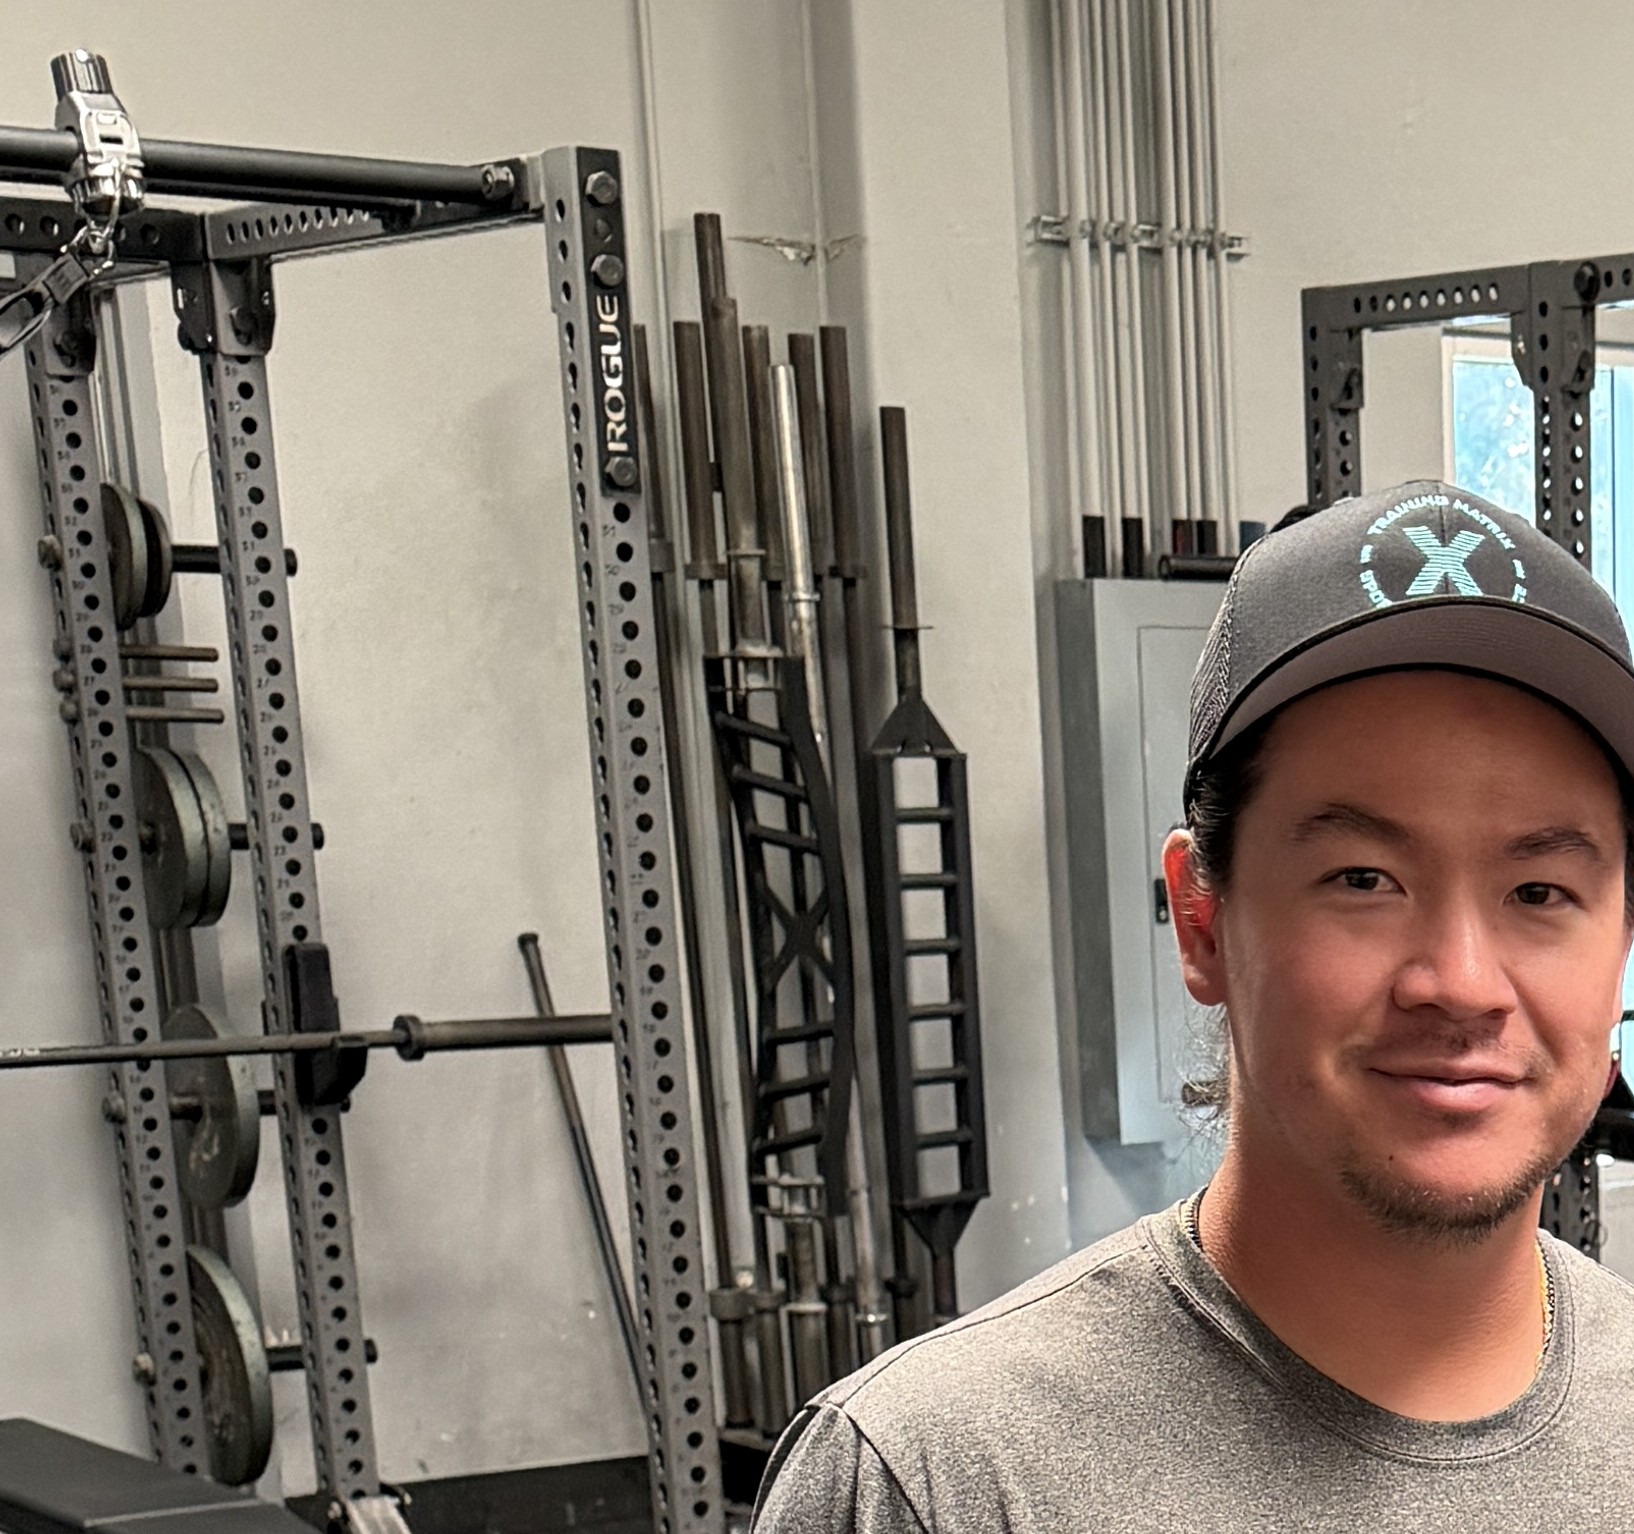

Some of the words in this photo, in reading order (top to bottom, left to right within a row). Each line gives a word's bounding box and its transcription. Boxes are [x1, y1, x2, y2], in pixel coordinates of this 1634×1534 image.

[596, 294, 629, 452] ROGUE
[1366, 494, 1450, 535] TRAINING
[1452, 498, 1517, 550] MATRIX
